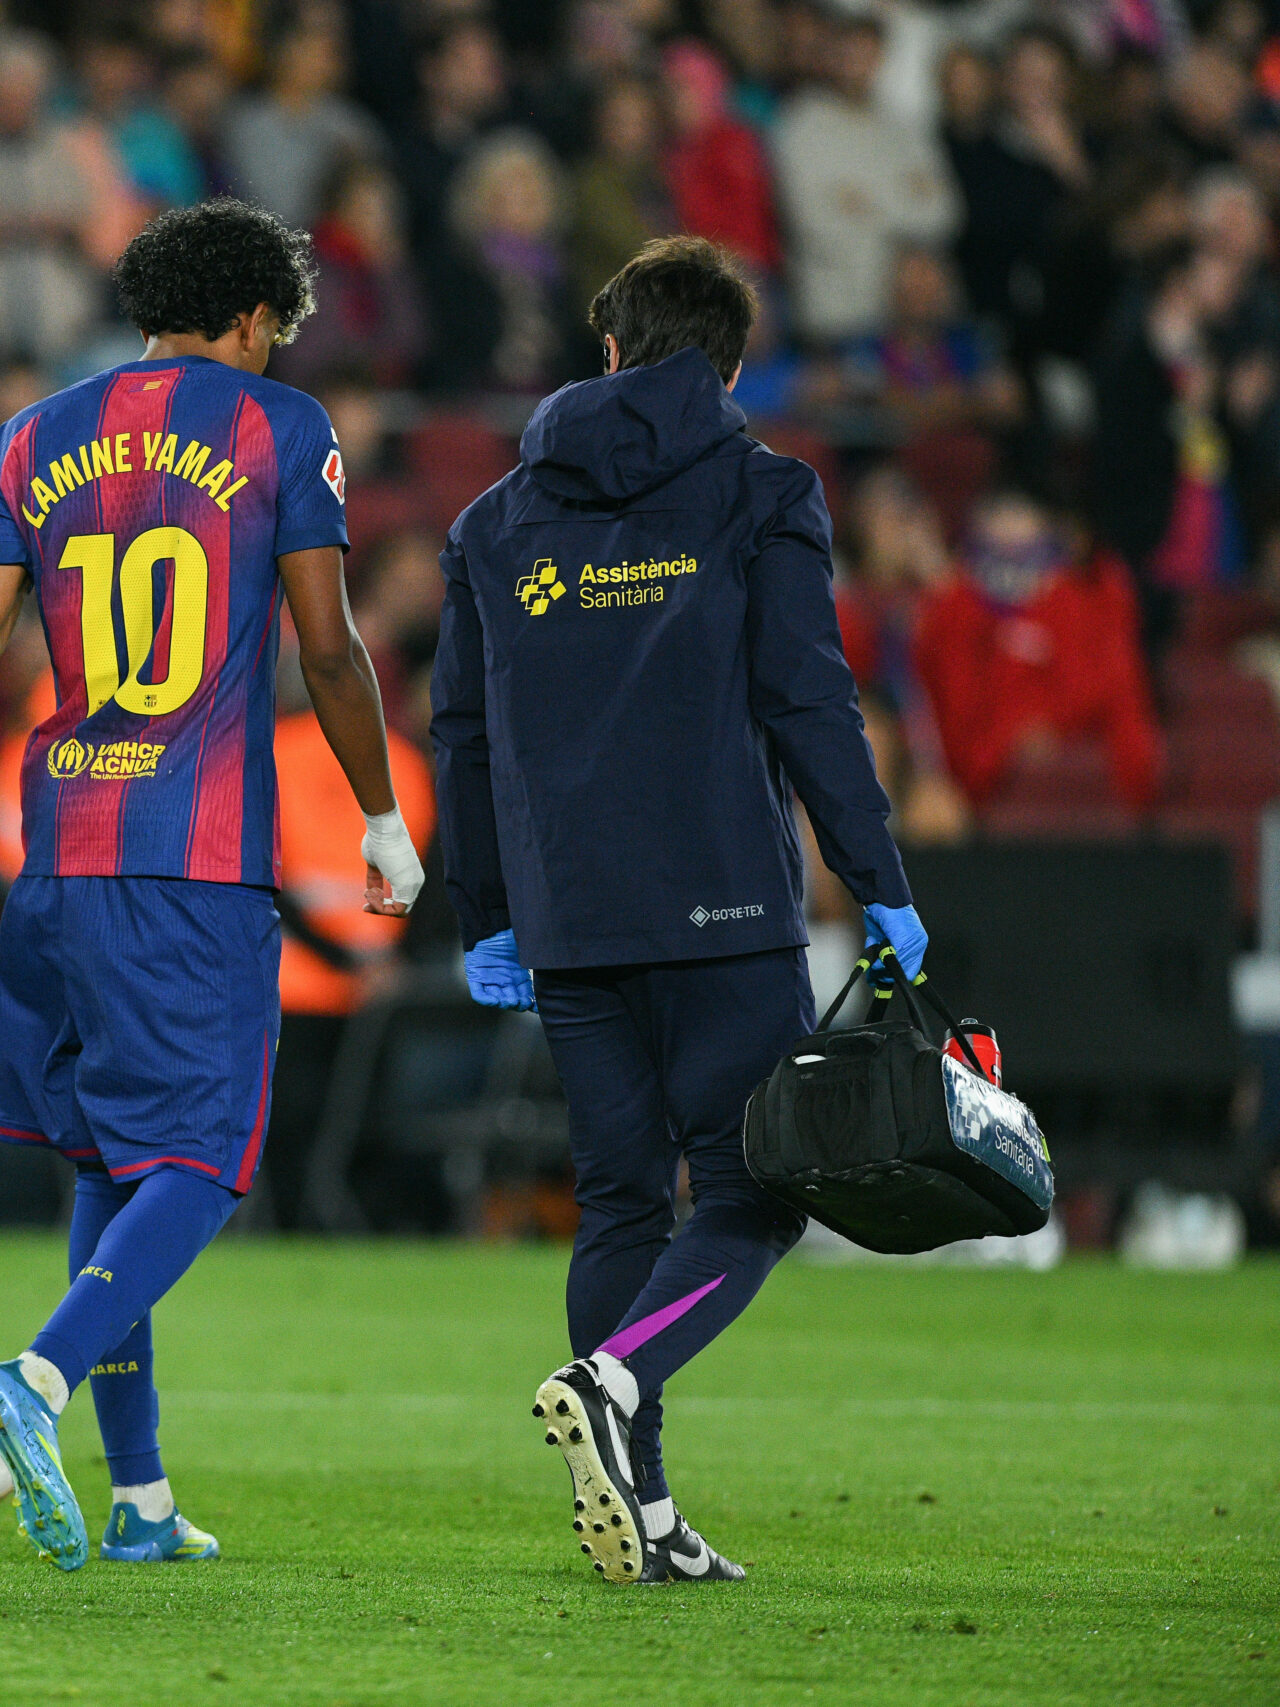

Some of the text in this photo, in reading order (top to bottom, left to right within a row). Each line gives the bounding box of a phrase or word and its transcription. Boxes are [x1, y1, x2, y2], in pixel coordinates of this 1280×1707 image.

[21, 431, 250, 529] LAMINE YAMAL
[578, 553, 698, 585] Assistència
[579, 581, 664, 609] Sanitària
[57, 526, 209, 719] 10
[97, 742, 166, 759] UNHCR
[90, 757, 158, 774] ACNUR
[711, 904, 765, 921] GORE-TEX
[995, 1125, 1034, 1176] Sanitària
[80, 1265, 113, 1283] ARÇA
